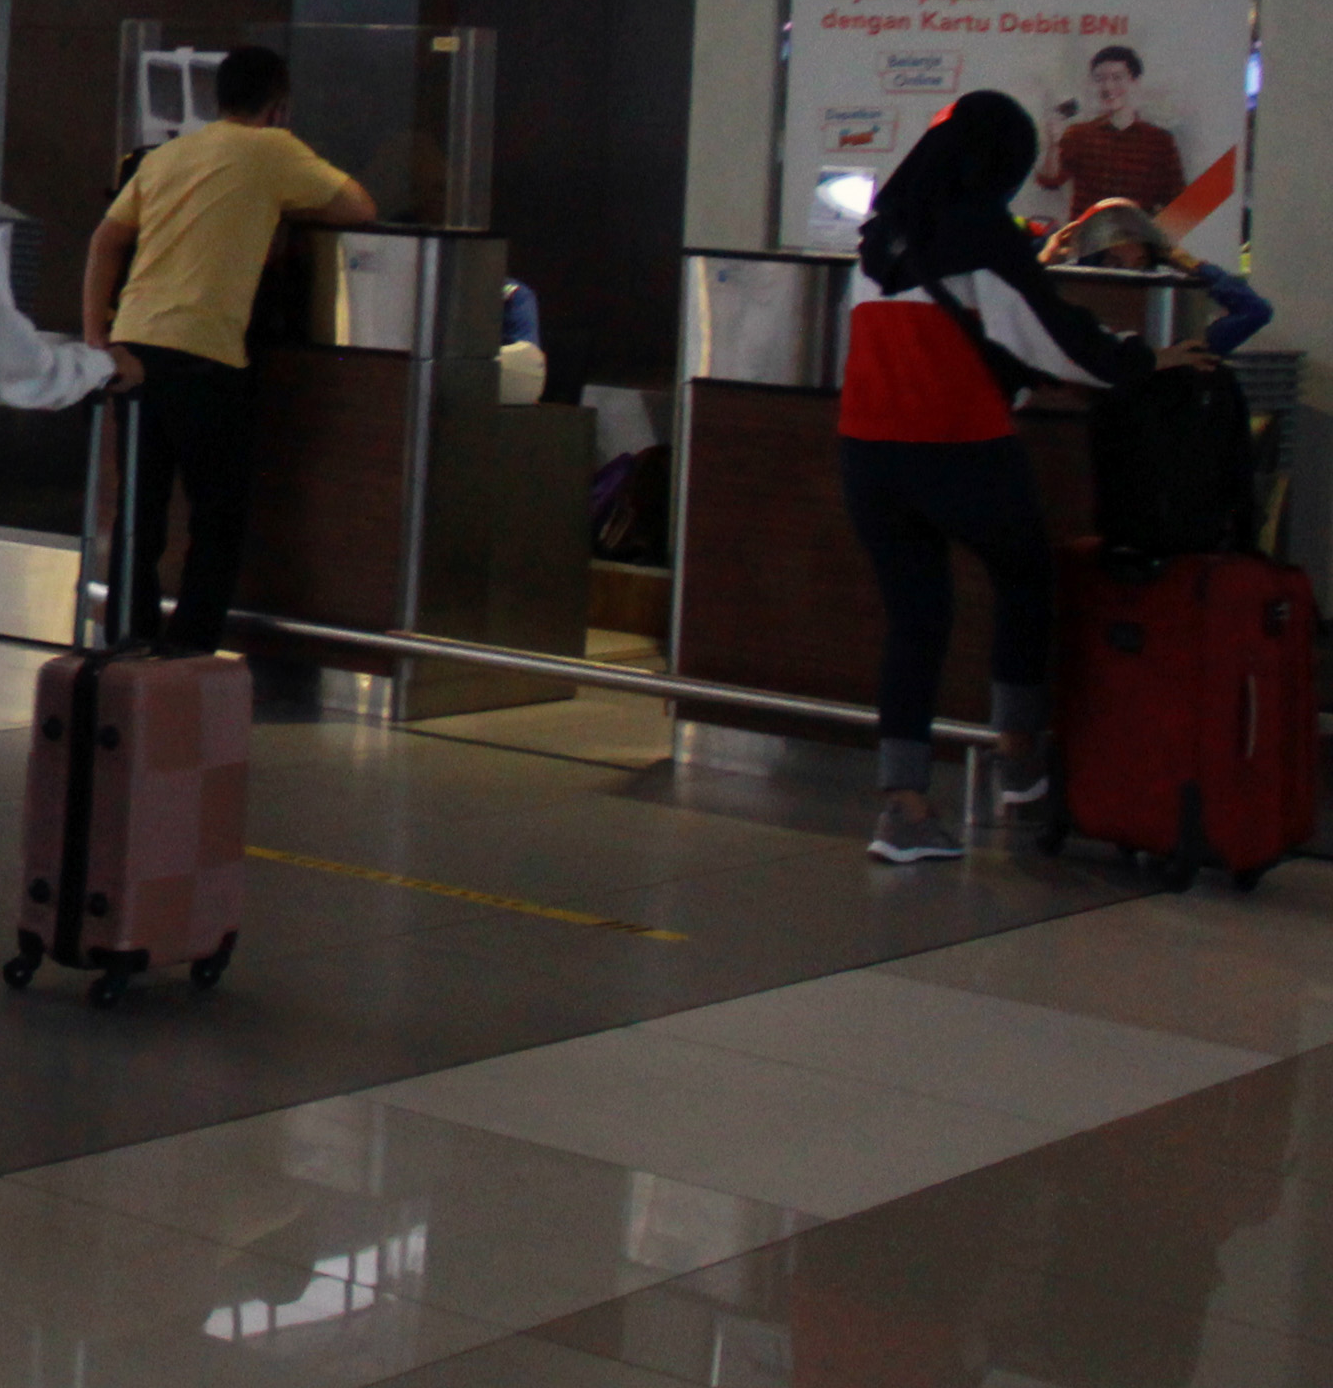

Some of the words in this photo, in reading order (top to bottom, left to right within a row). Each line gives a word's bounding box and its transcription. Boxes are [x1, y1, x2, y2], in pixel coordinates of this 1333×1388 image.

[821, 9, 911, 35] dengan
[920, 11, 991, 33] Kartu
[998, 11, 1071, 35] Debit
[1080, 13, 1129, 35] BNI
